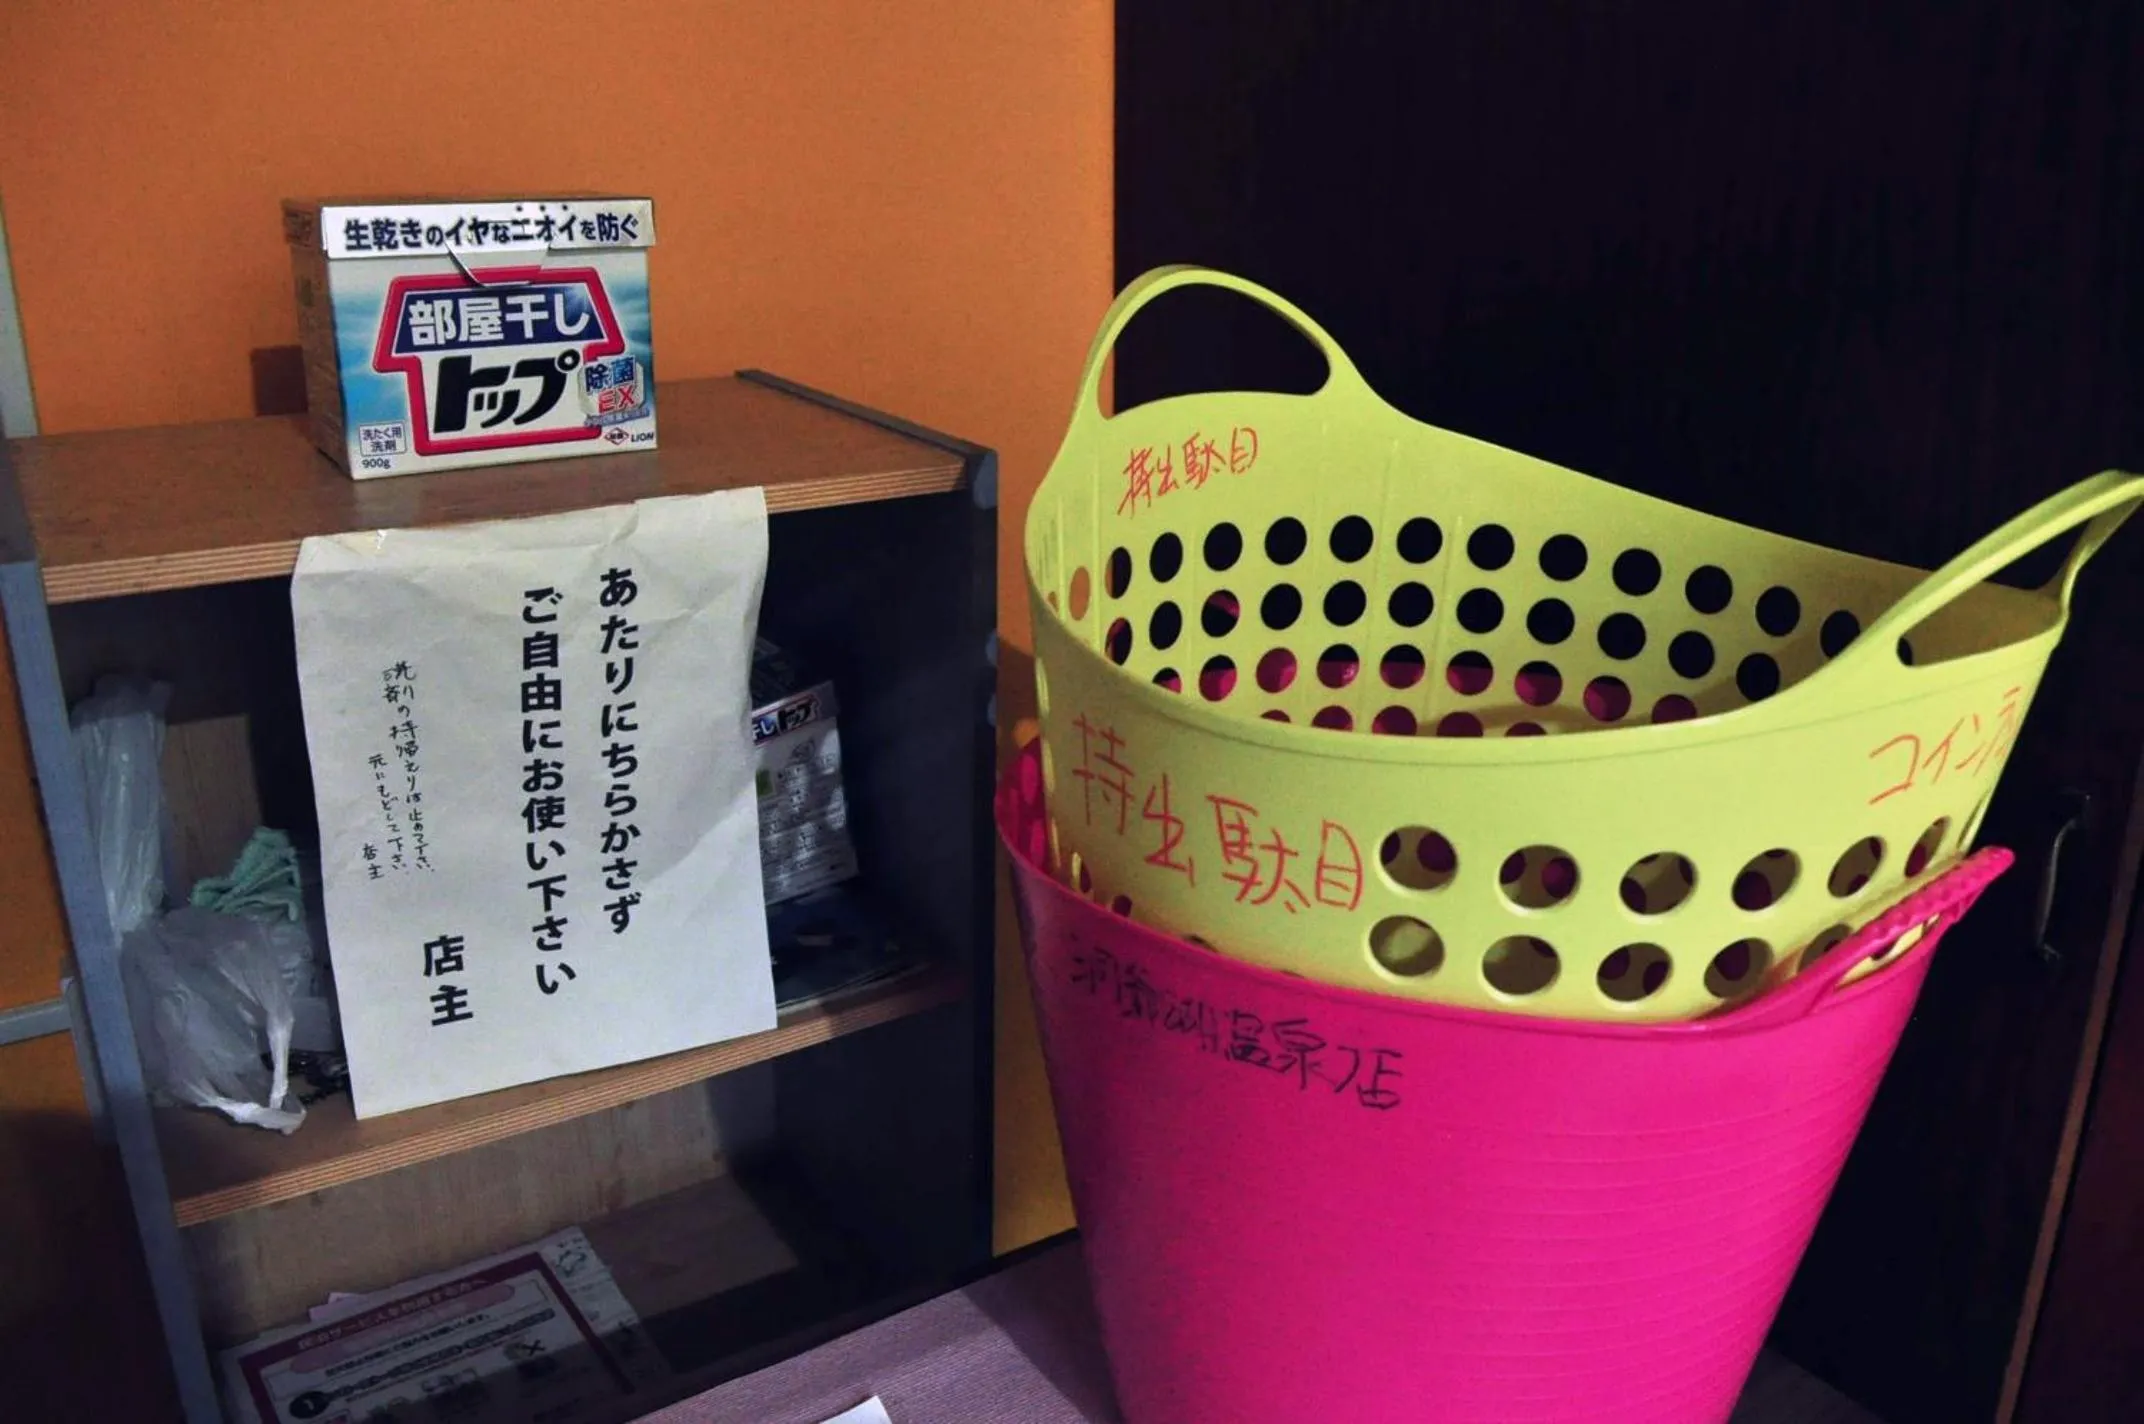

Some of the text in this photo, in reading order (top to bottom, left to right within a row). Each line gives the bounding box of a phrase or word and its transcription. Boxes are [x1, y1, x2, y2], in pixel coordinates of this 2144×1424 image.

[344, 213, 640, 250] 生乾きのイヤなニオイを防ぐ
[408, 293, 591, 346] 部屋干し
[434, 348, 581, 434] トップ
[585, 357, 635, 392] 除菌
[599, 385, 635, 413] EX
[362, 426, 403, 441] 洗たく用
[371, 440, 397, 452] 洗剤
[631, 432, 654, 443] LION
[362, 458, 391, 469] 900g
[599, 568, 642, 934] あたりにちらかさず
[1868, 686, 2021, 805] コインラ
[520, 587, 577, 995] ご自由にお使い下さい
[1073, 712, 1364, 913] 持出駄目
[362, 843, 384, 880] 店主
[423, 935, 473, 1027] 店主
